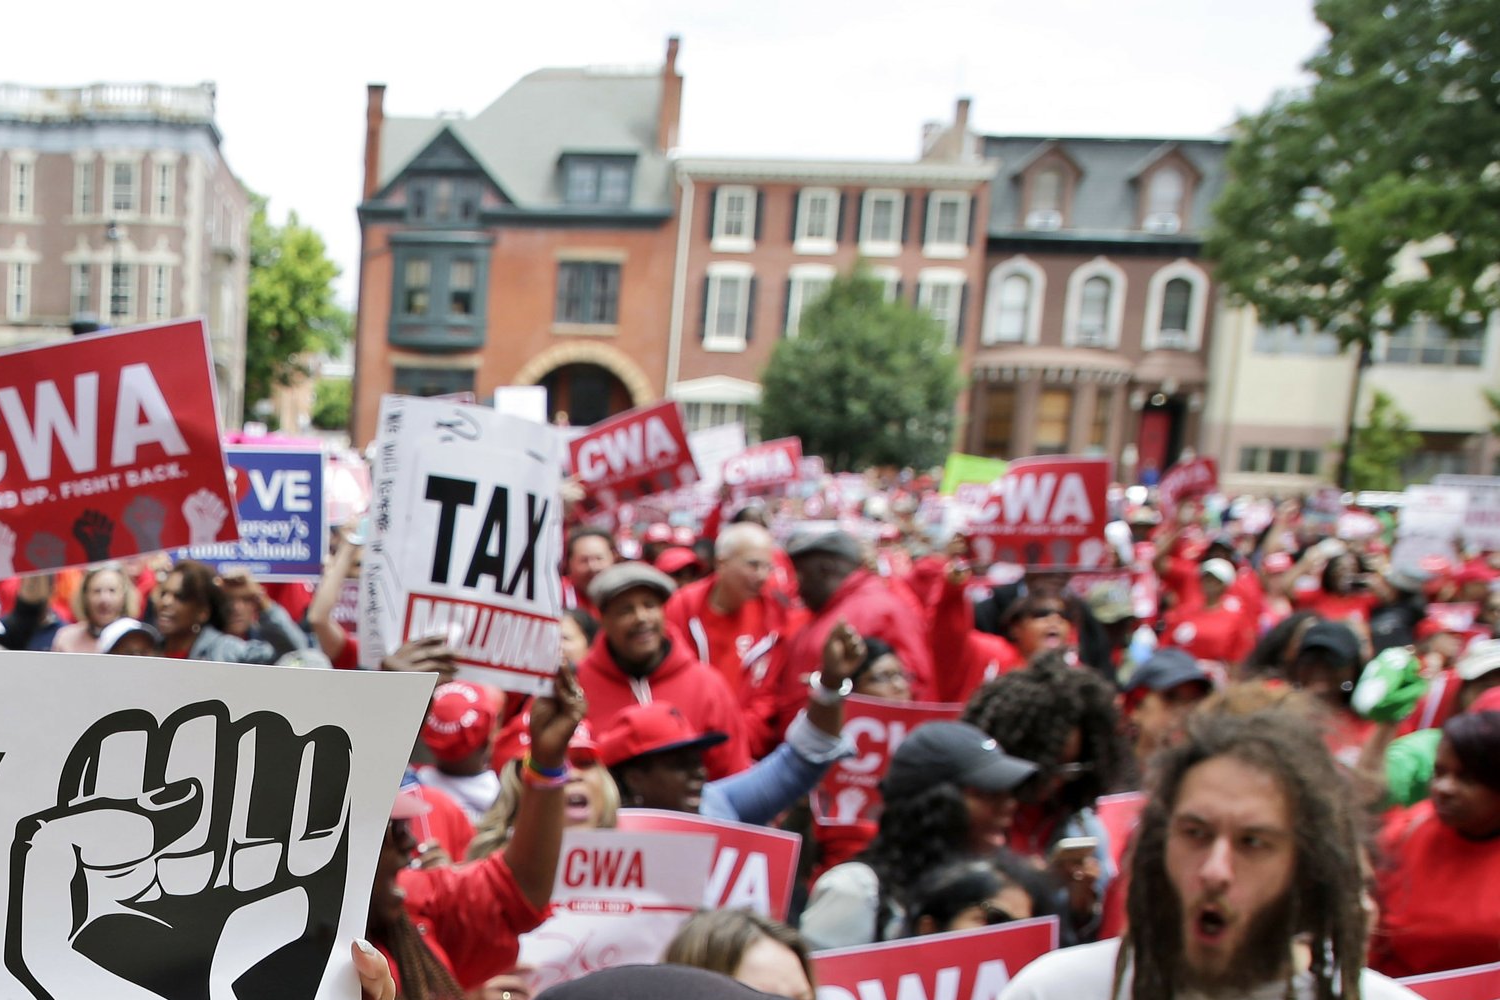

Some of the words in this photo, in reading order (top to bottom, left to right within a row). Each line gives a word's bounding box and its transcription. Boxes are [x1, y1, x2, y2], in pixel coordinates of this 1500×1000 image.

[577, 416, 680, 481] CWA
[724, 448, 795, 485] CWA
[21, 486, 57, 506] UP.
[59, 473, 121, 499] FIGHT
[125, 462, 188, 487] BACK.
[238, 514, 309, 542] ersey's
[425, 474, 549, 600] TAX
[563, 847, 646, 889] CWA
